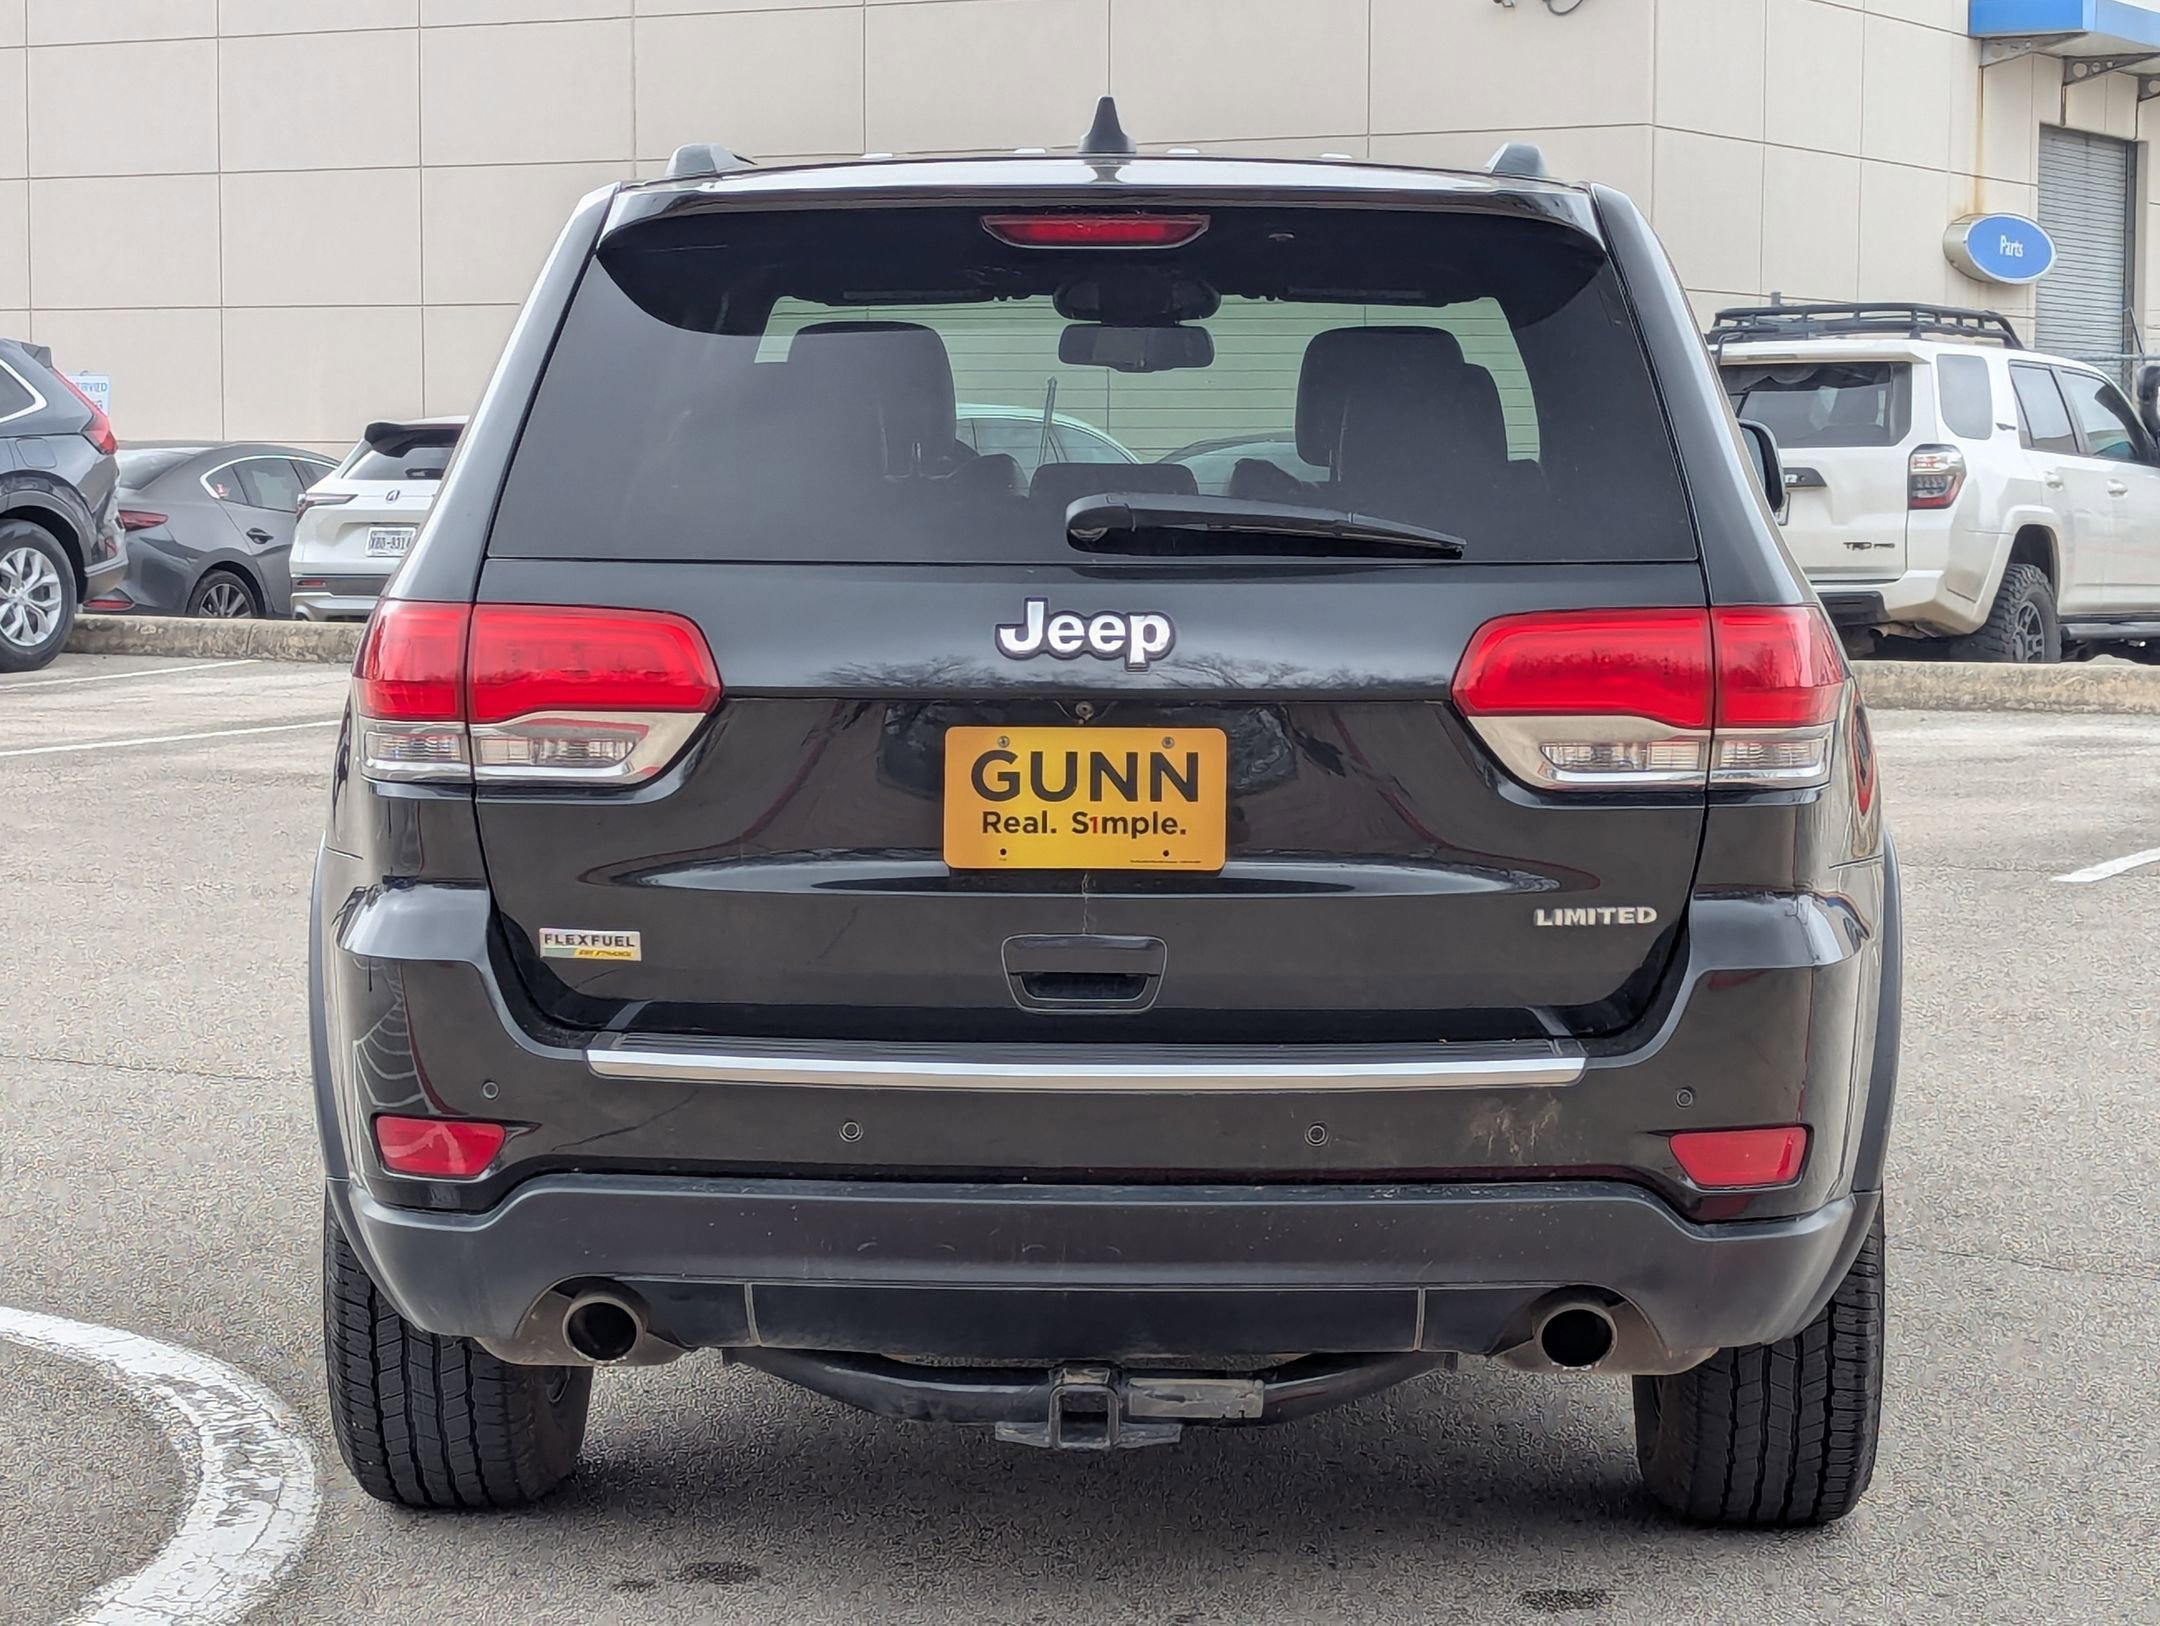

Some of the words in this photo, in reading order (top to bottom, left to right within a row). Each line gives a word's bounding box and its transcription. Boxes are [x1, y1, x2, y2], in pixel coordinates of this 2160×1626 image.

[2000, 233, 2024, 258] Parts
[995, 597, 1176, 672] Jeep
[970, 749, 1199, 802] GUNN
[982, 810, 1057, 834] Real.
[1535, 906, 1658, 926] LIMITED
[544, 933, 635, 947] FLEXFUEL
